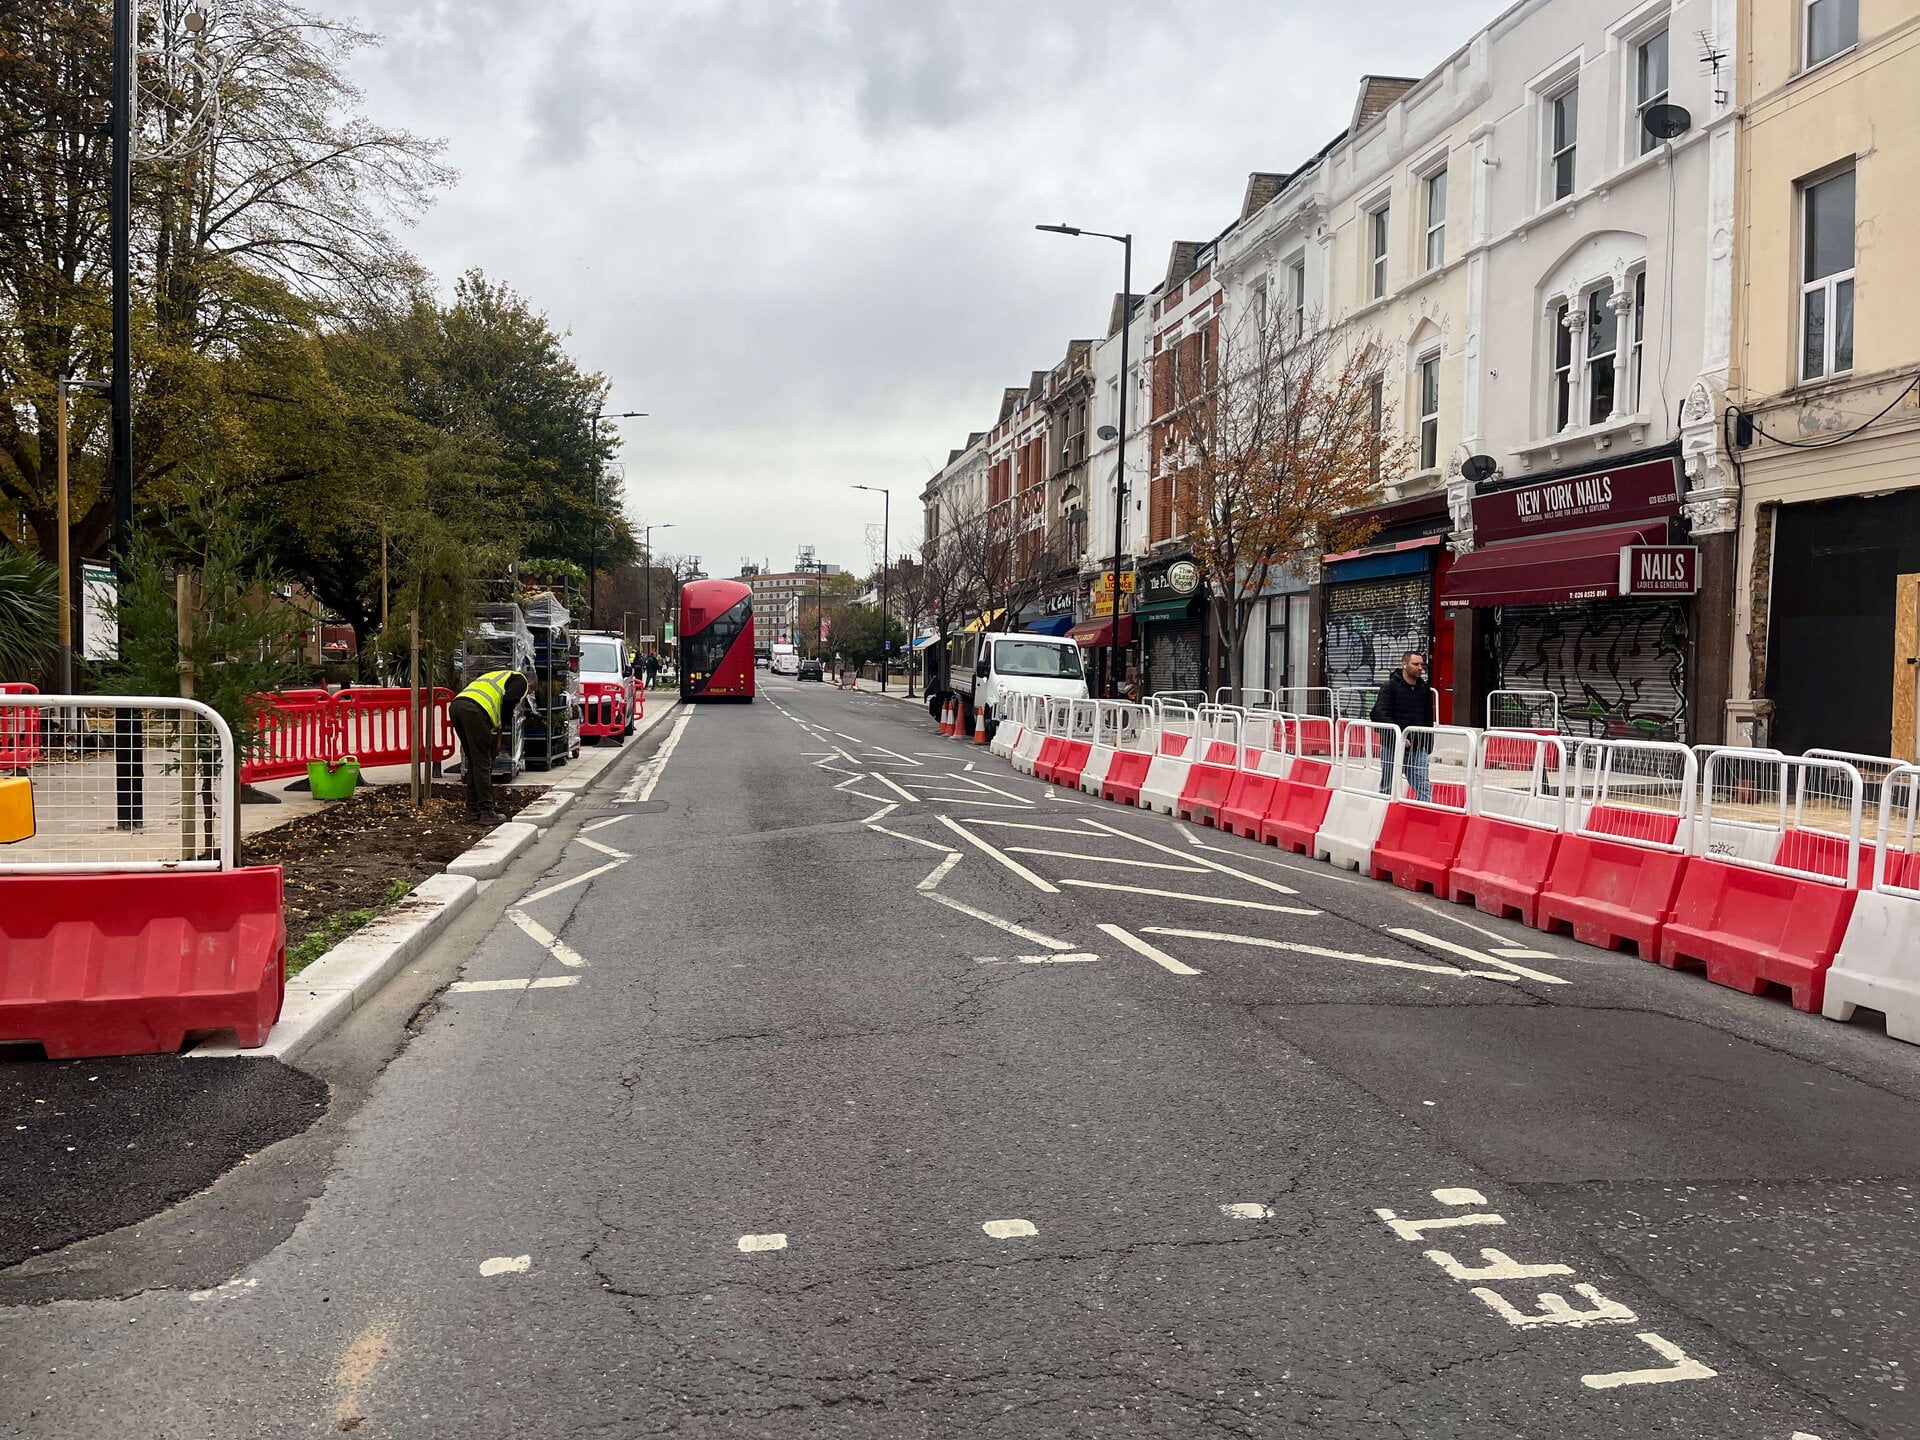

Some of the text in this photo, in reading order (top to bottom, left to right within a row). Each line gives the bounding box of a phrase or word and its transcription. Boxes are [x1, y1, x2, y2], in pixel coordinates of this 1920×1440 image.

[1516, 476, 1612, 516] NEW YORK NAILS
[1521, 513, 1543, 523] PROFESSIONAL
[1571, 506, 1583, 515] LADIES
[1588, 503, 1610, 513] GENTLEMEN
[1641, 553, 1685, 580] NAILS
[1107, 573, 1129, 582] OF
[1636, 581, 1689, 589] LADIES & GENTLEMEN
